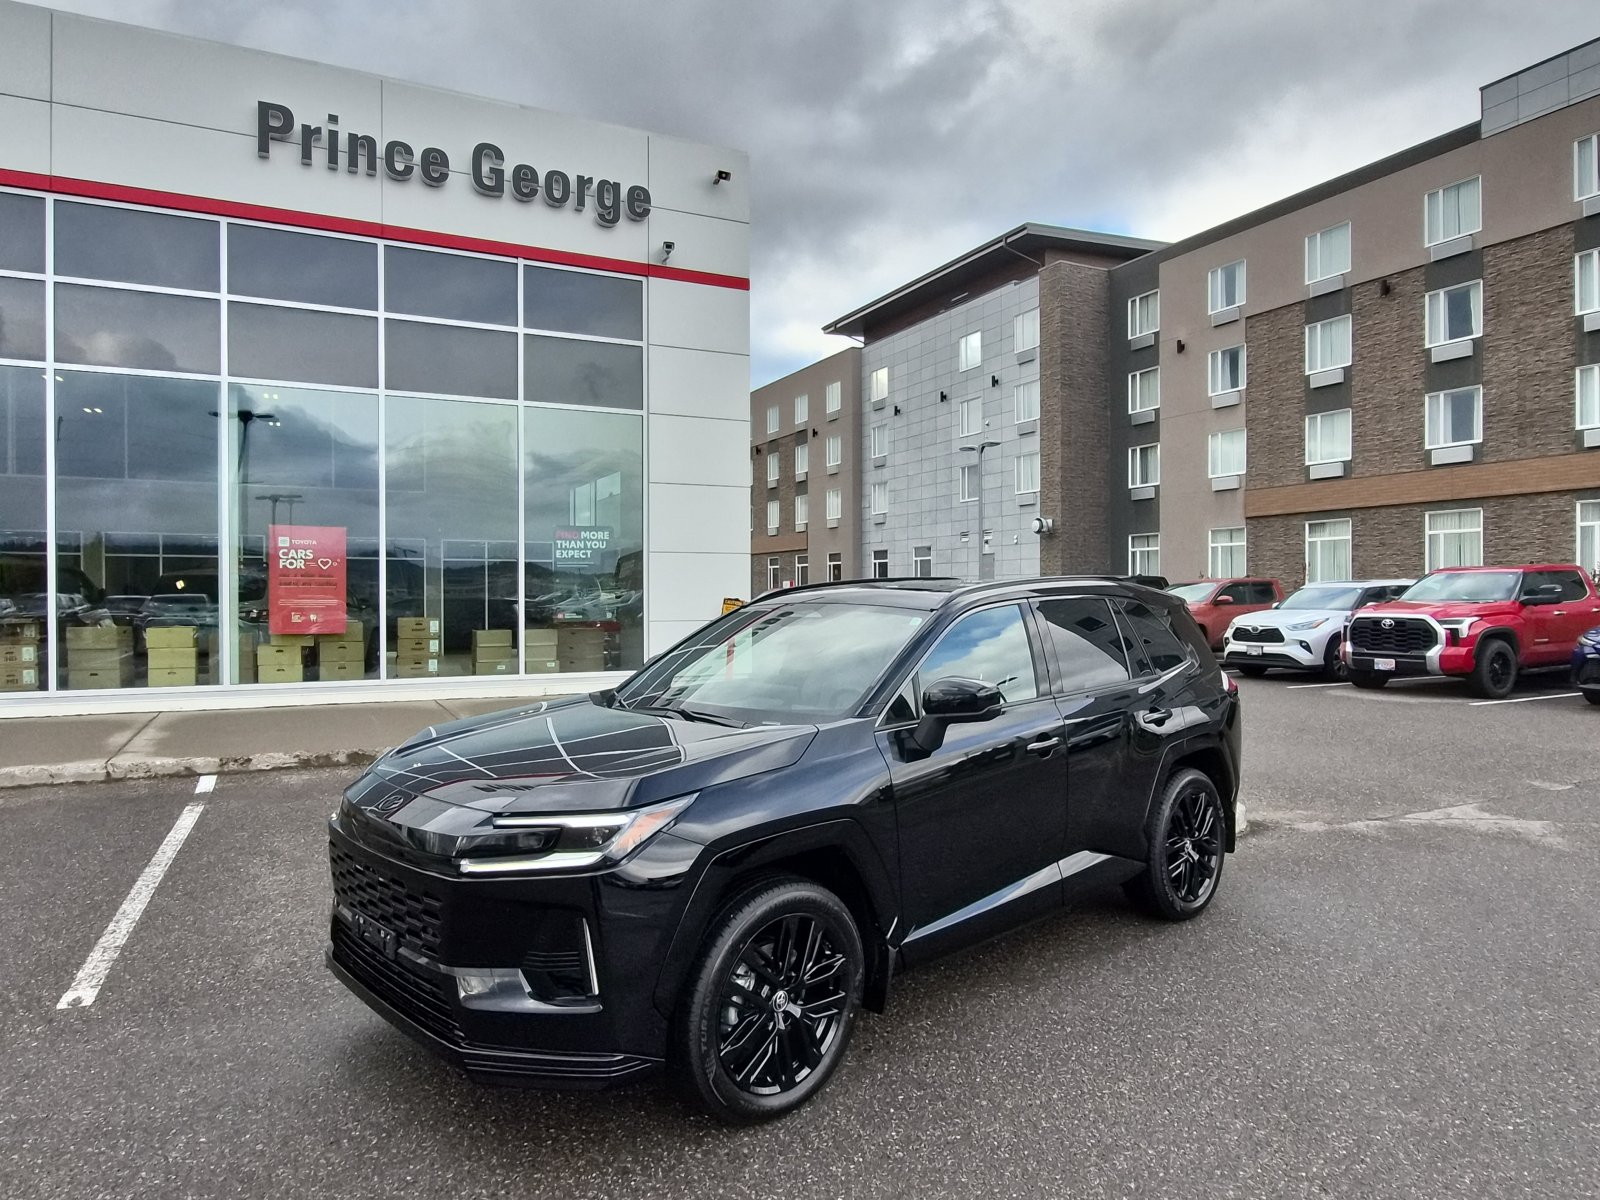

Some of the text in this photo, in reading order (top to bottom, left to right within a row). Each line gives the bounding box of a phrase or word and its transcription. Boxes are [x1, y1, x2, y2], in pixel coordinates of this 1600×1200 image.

[257, 100, 652, 227] Prince George
[580, 530, 610, 540] MORE
[556, 540, 607, 549] THAN YOU
[278, 549, 314, 559] CARS
[555, 550, 592, 559] EXPECT
[279, 559, 305, 569] FOR
